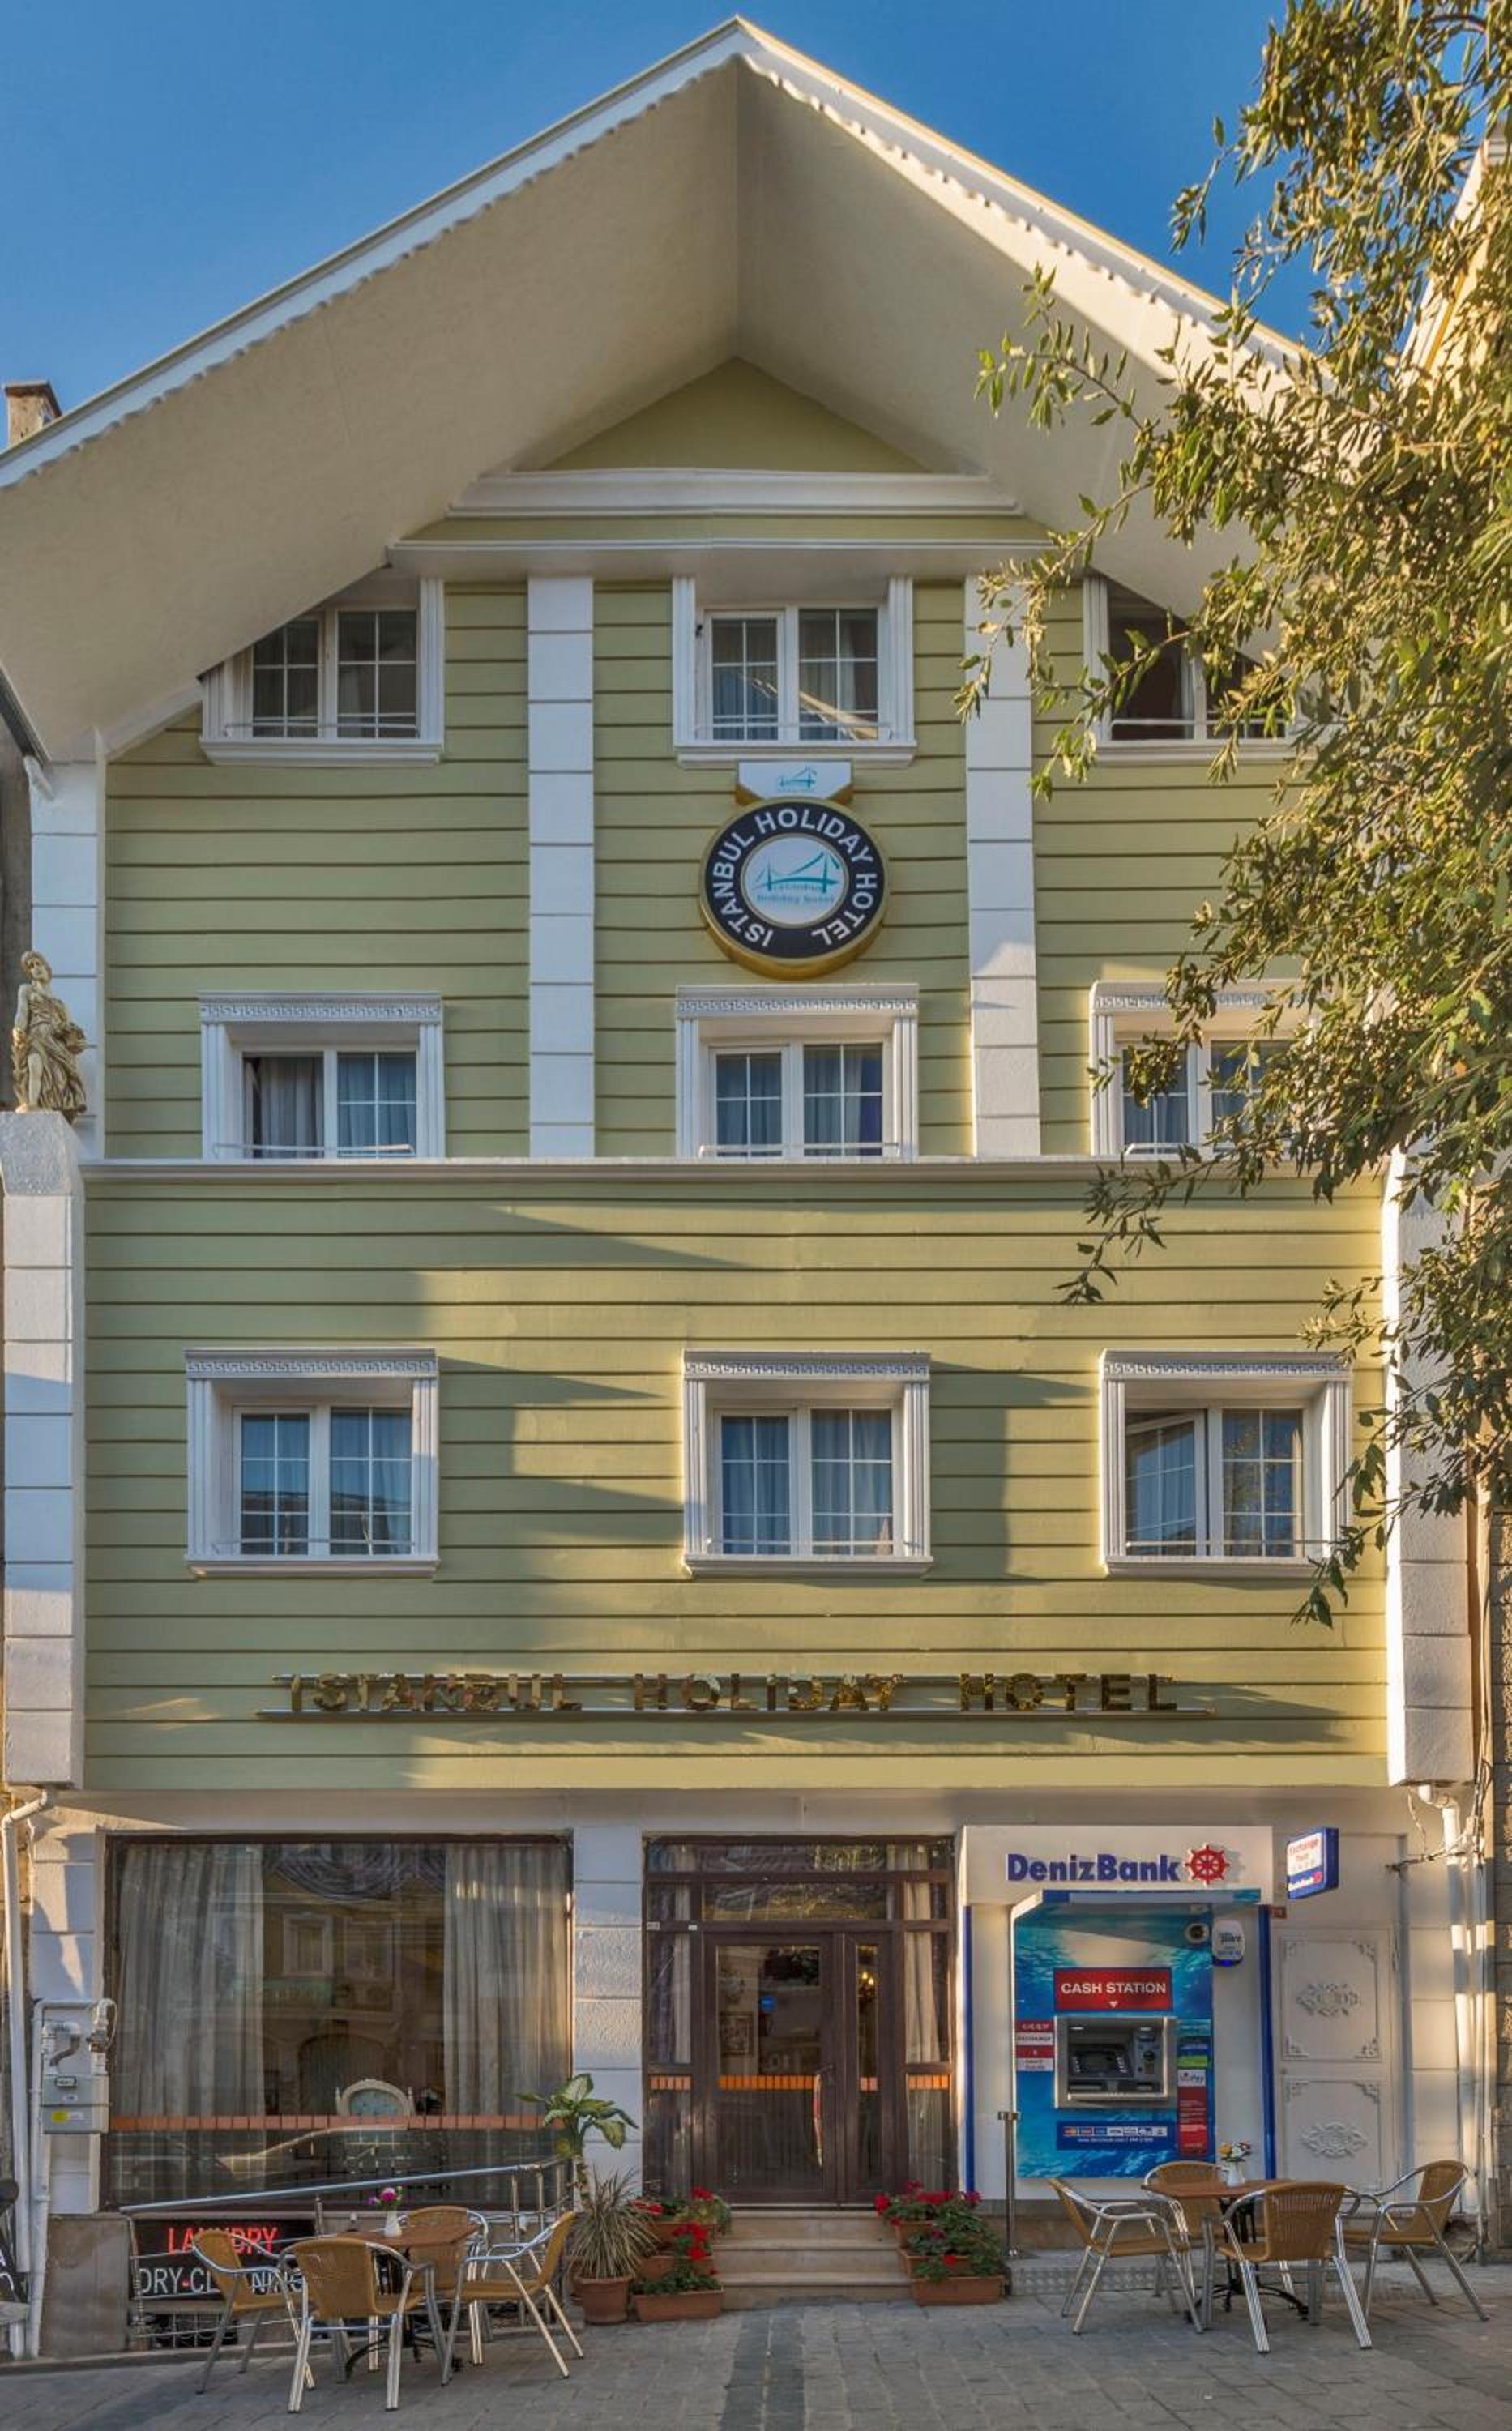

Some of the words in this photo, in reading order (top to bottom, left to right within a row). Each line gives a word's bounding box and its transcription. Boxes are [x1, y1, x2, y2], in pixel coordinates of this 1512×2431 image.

[754, 809, 873, 864] HOLIDAY
[712, 832, 773, 947] ISTANBUL
[811, 873, 878, 946] HOTEL
[289, 1673, 582, 1712] ISTANBUL
[634, 1673, 903, 1712] HOLIDAY
[959, 1673, 1177, 1712] HOTEL
[1006, 1853, 1181, 1882] DenizBank
[1061, 1982, 1102, 1994] CASH
[1106, 1982, 1167, 1994] STATION
[168, 2227, 277, 2256] LADRY
